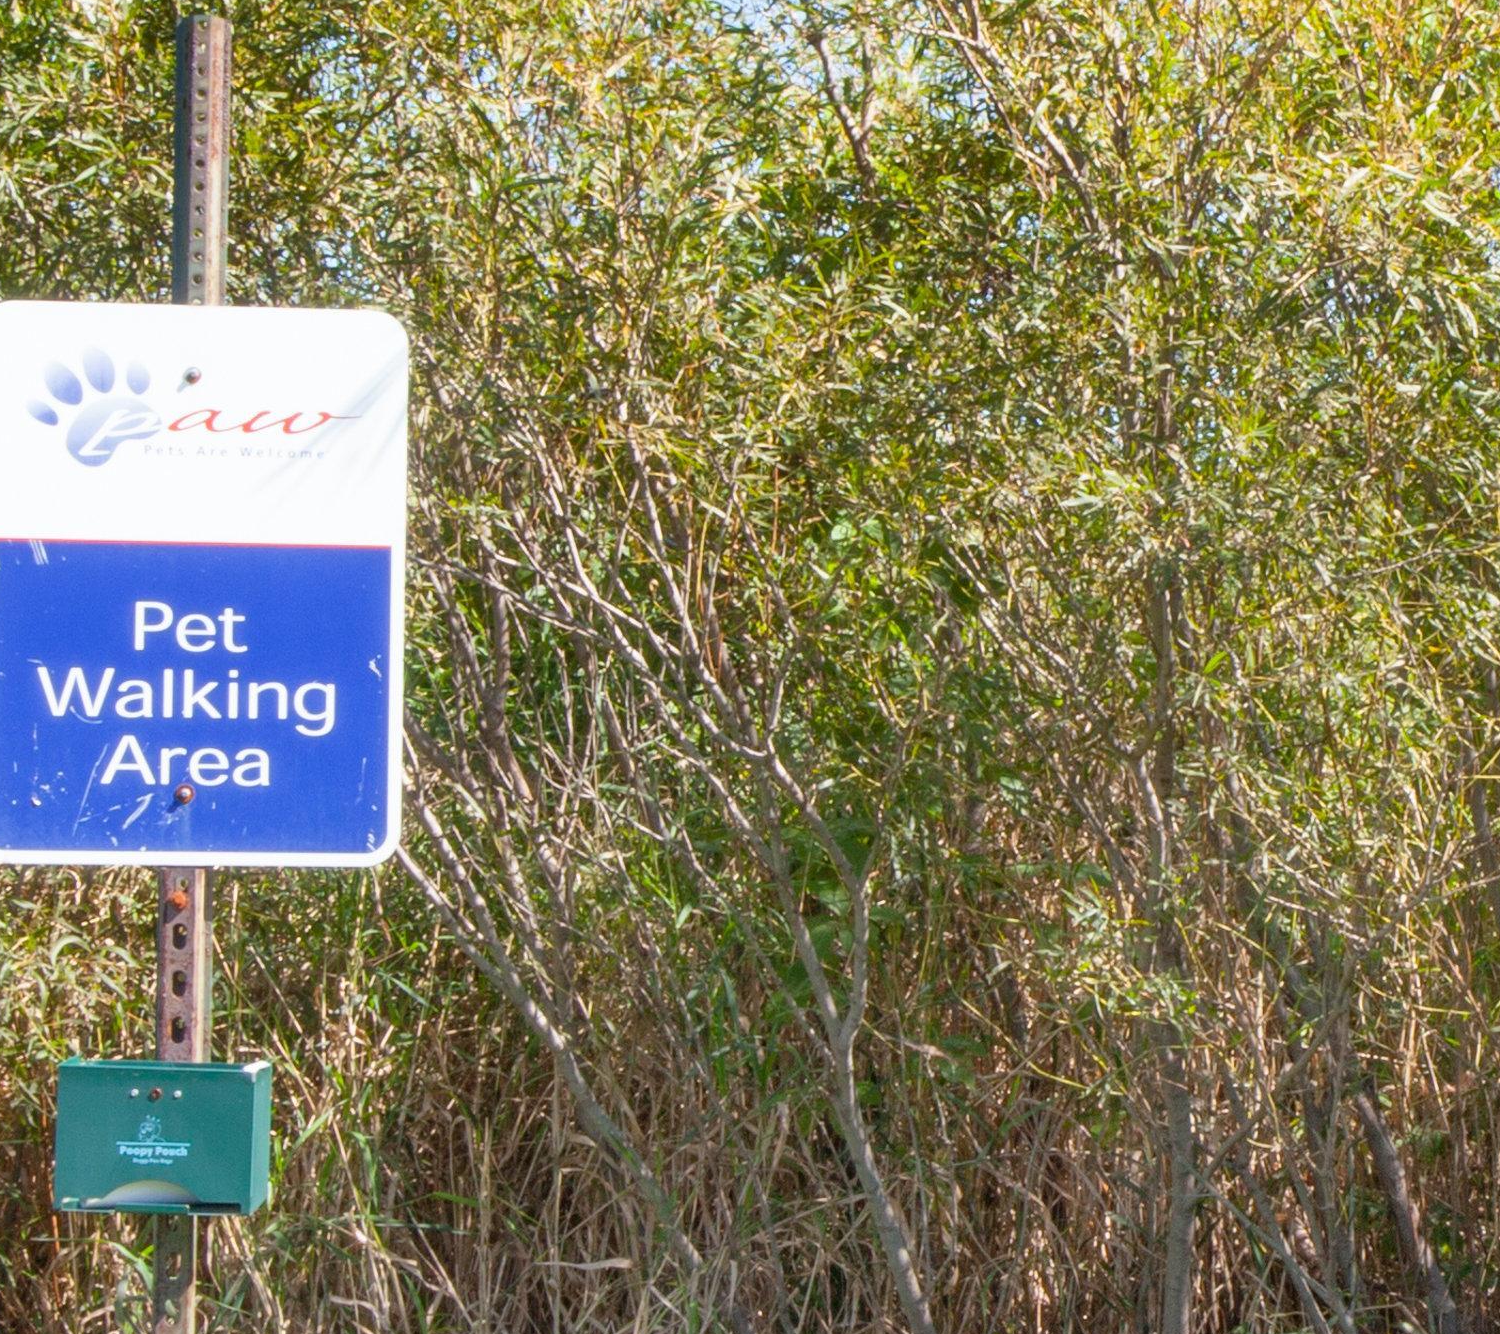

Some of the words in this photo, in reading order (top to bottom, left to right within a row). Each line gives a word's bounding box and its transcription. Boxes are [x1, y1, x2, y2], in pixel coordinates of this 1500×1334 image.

[143, 444, 185, 457] Pets
[196, 445, 228, 458] Are
[239, 446, 326, 459] Welcome
[133, 601, 248, 653] Pet
[36, 667, 336, 737] Walking
[100, 735, 271, 788] Area
